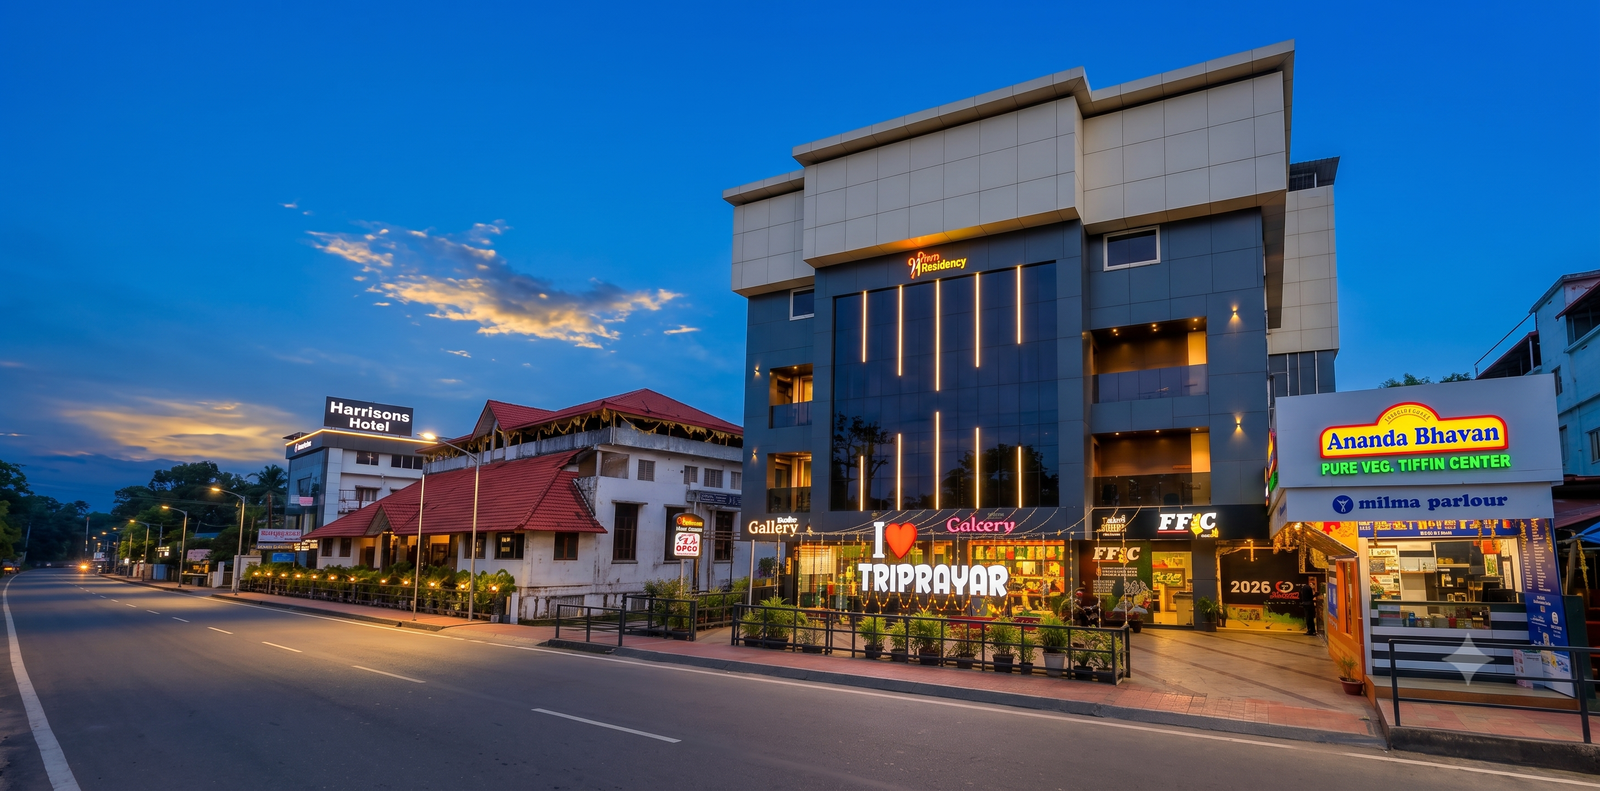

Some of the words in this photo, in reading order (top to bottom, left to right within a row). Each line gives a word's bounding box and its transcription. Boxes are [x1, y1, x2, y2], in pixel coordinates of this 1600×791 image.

[921, 257, 967, 273] Residency
[330, 401, 410, 423] Harrisons
[349, 417, 390, 432] Hotel
[1327, 429, 1408, 451] Ananda
[1414, 426, 1499, 446] Bhavan
[1321, 461, 1358, 475] PURE
[1361, 459, 1395, 473] VEG.
[1398, 457, 1445, 472] TIFFIN
[1449, 454, 1511, 470] CENTER
[1358, 495, 1421, 510] milma
[1427, 494, 1508, 511] parlour
[748, 520, 799, 537] Gallery
[872, 521, 885, 559] I
[858, 563, 1009, 597] TRIPRAYAR
[1230, 580, 1271, 594] 2026
